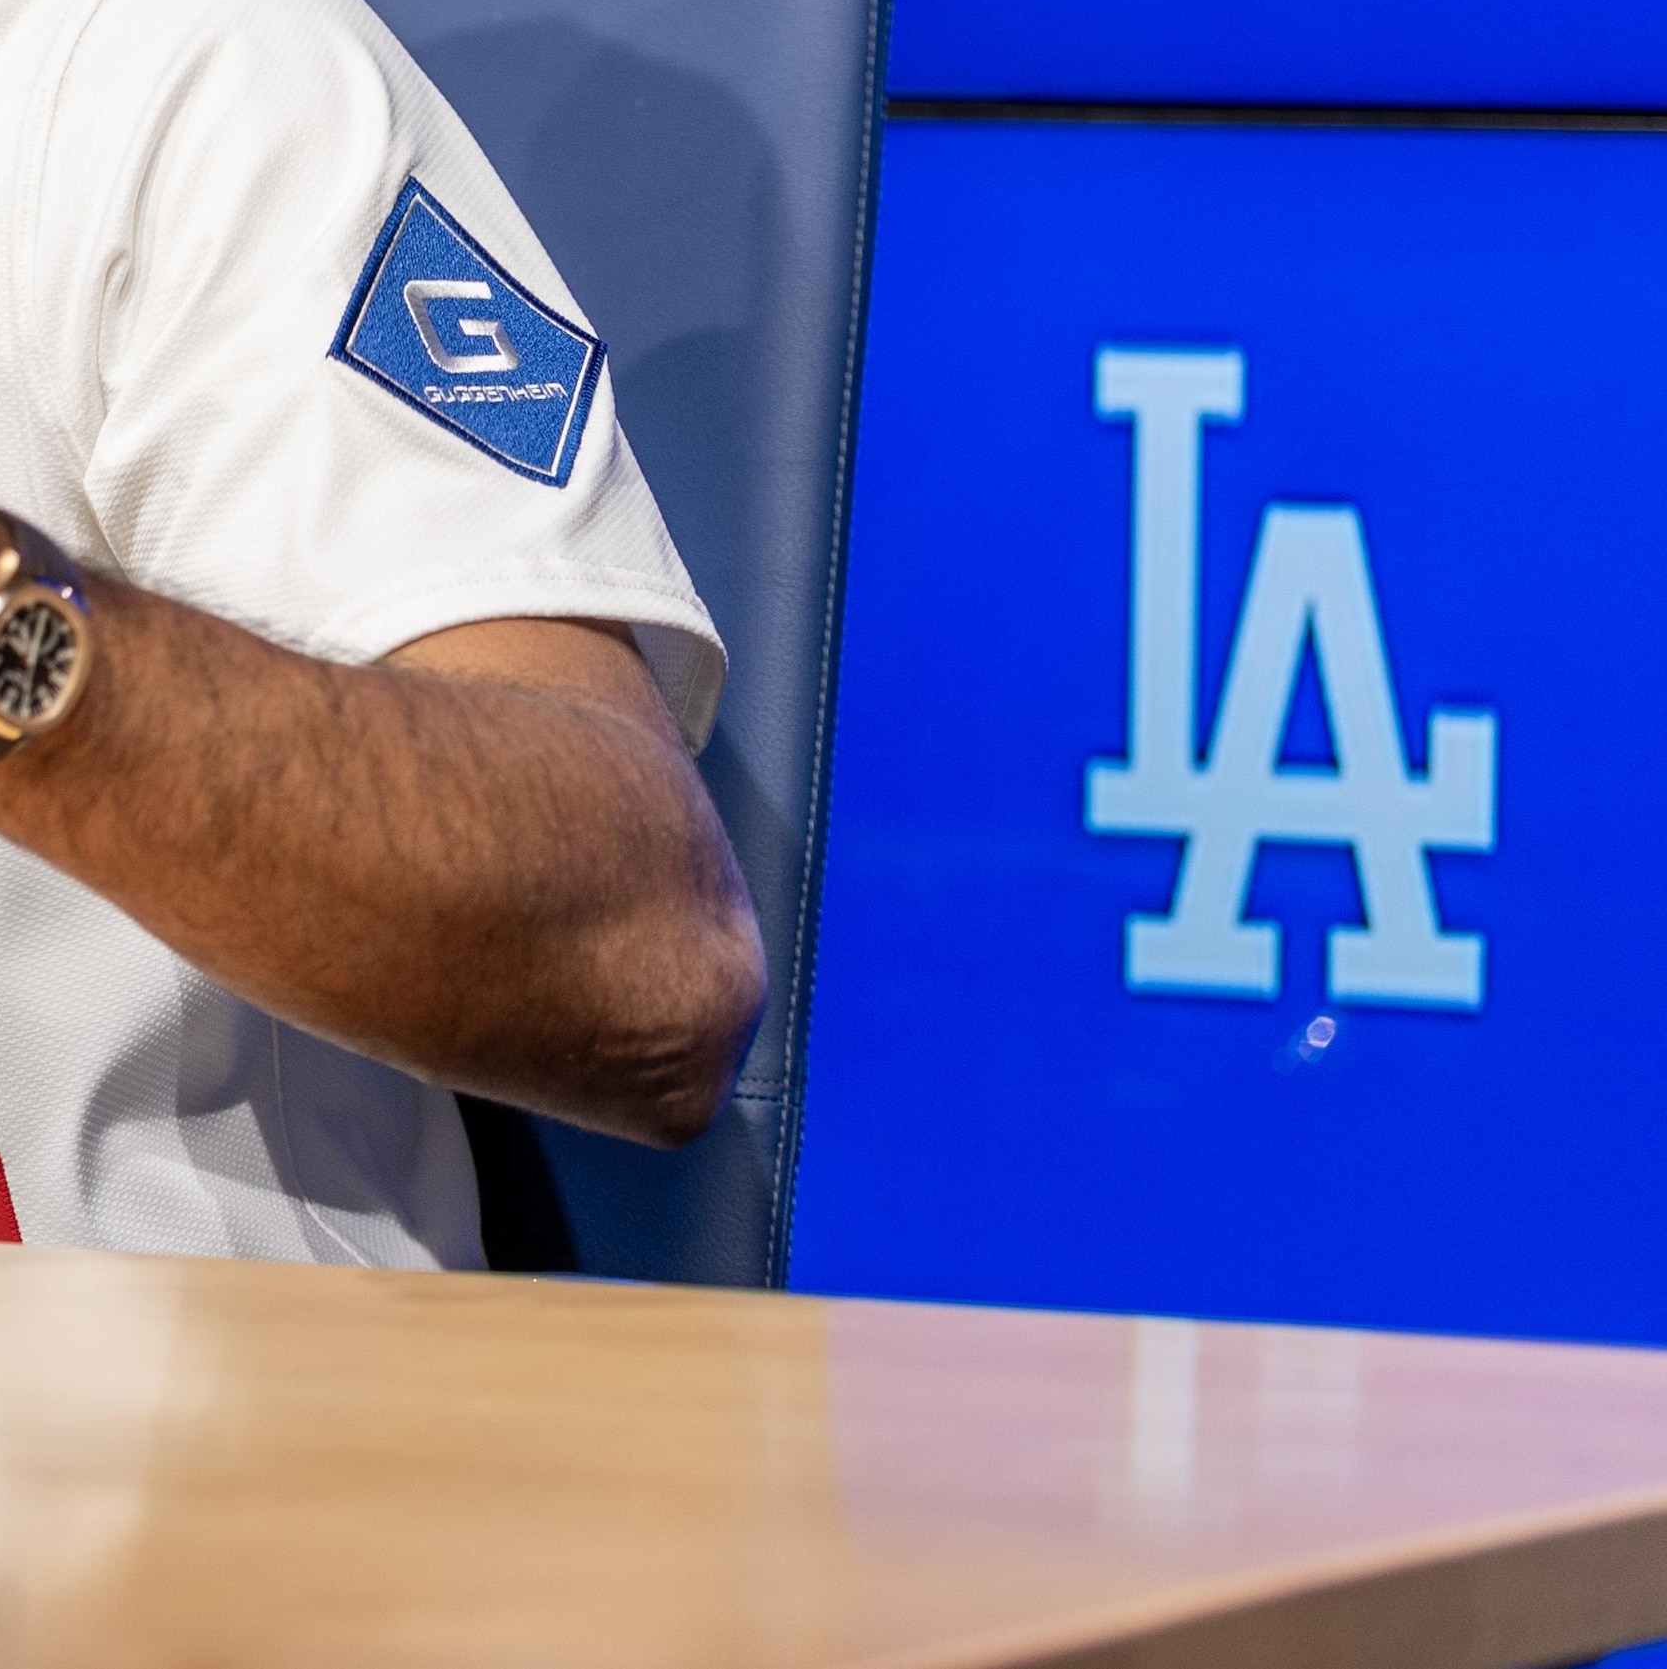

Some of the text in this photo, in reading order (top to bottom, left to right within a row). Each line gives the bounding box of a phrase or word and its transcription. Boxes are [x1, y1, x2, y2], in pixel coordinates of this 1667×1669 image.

[404, 280, 518, 374] G
[423, 382, 568, 403] GUGGENHEIM
[1085, 344, 1496, 1010] LA
